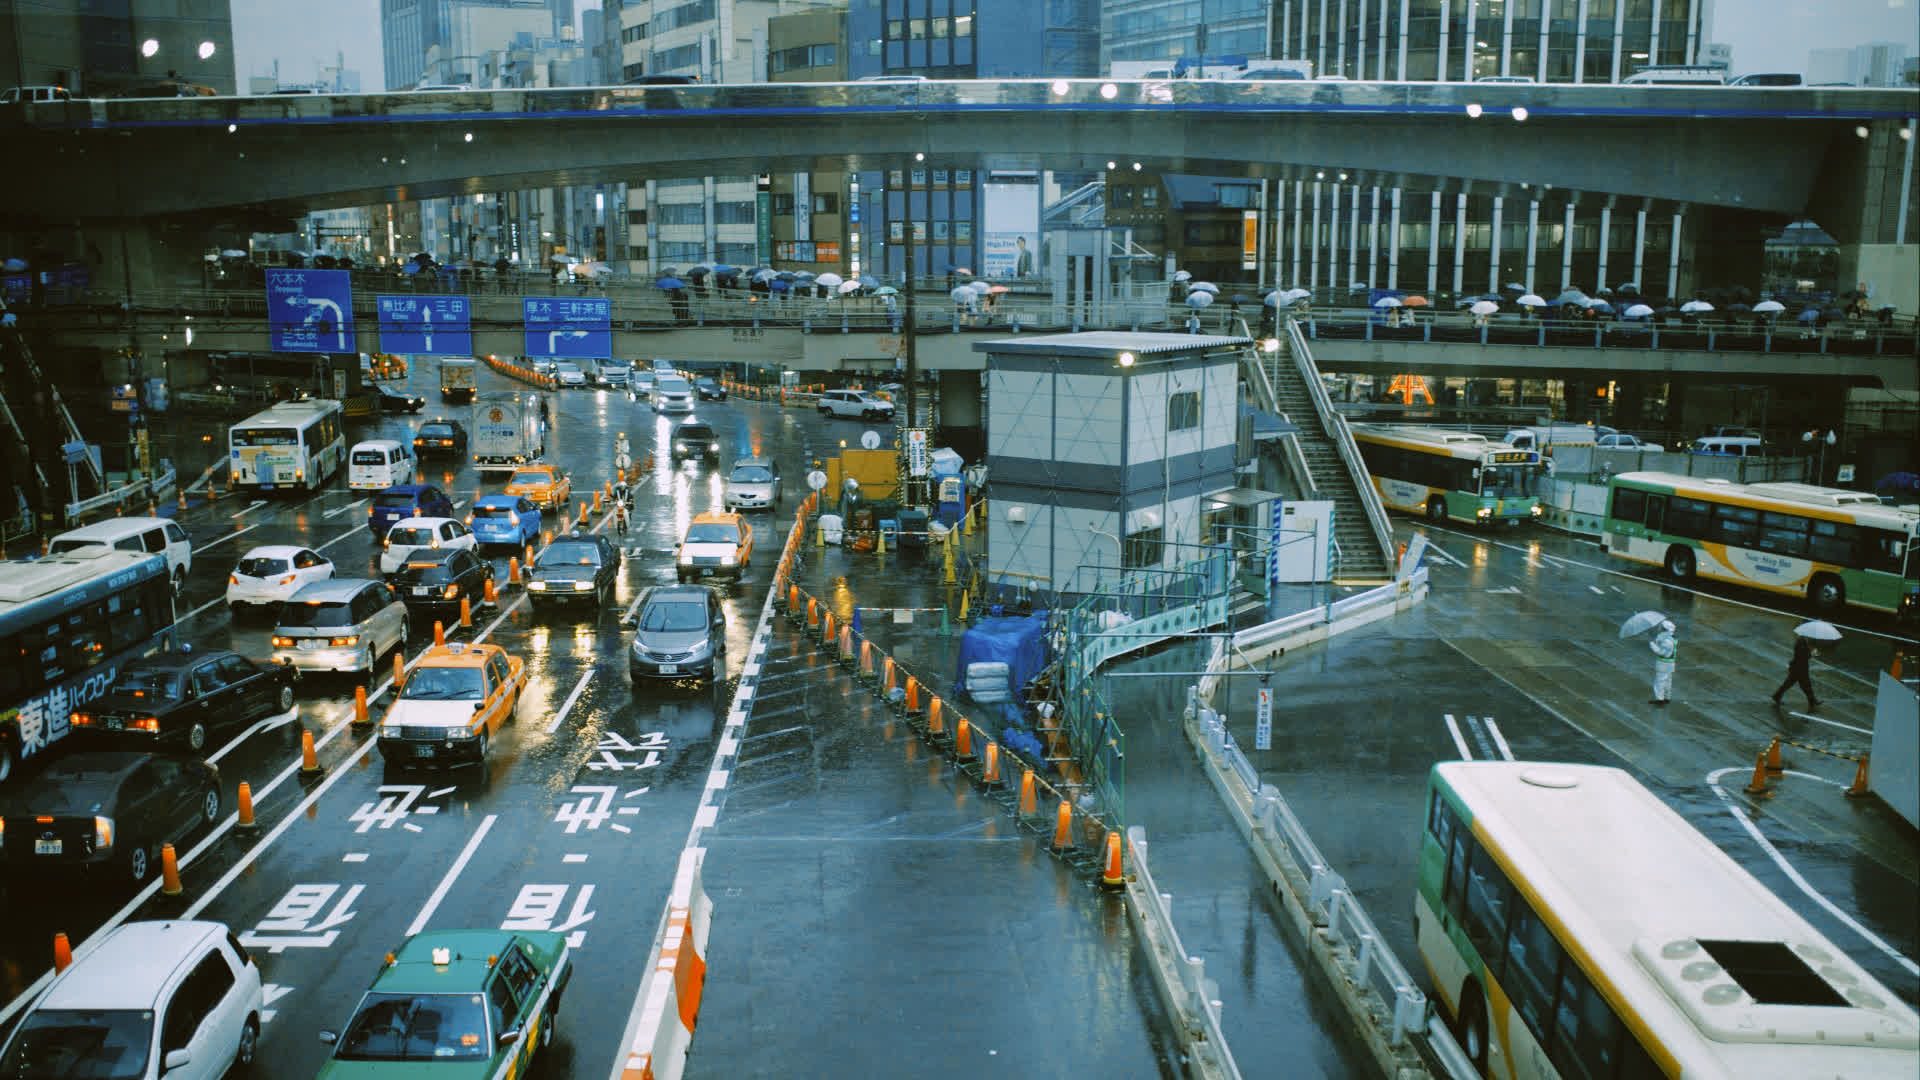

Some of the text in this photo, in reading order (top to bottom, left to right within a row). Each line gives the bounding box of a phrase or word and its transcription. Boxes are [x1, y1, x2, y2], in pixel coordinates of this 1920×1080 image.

[271, 272, 305, 285] 六本木
[383, 299, 417, 312] 恵比寿
[436, 299, 463, 313] 三田
[527, 300, 552, 313] 厚木
[559, 301, 608, 315] 三軒茶屋
[18, 666, 117, 760] 東進ハイスクール
